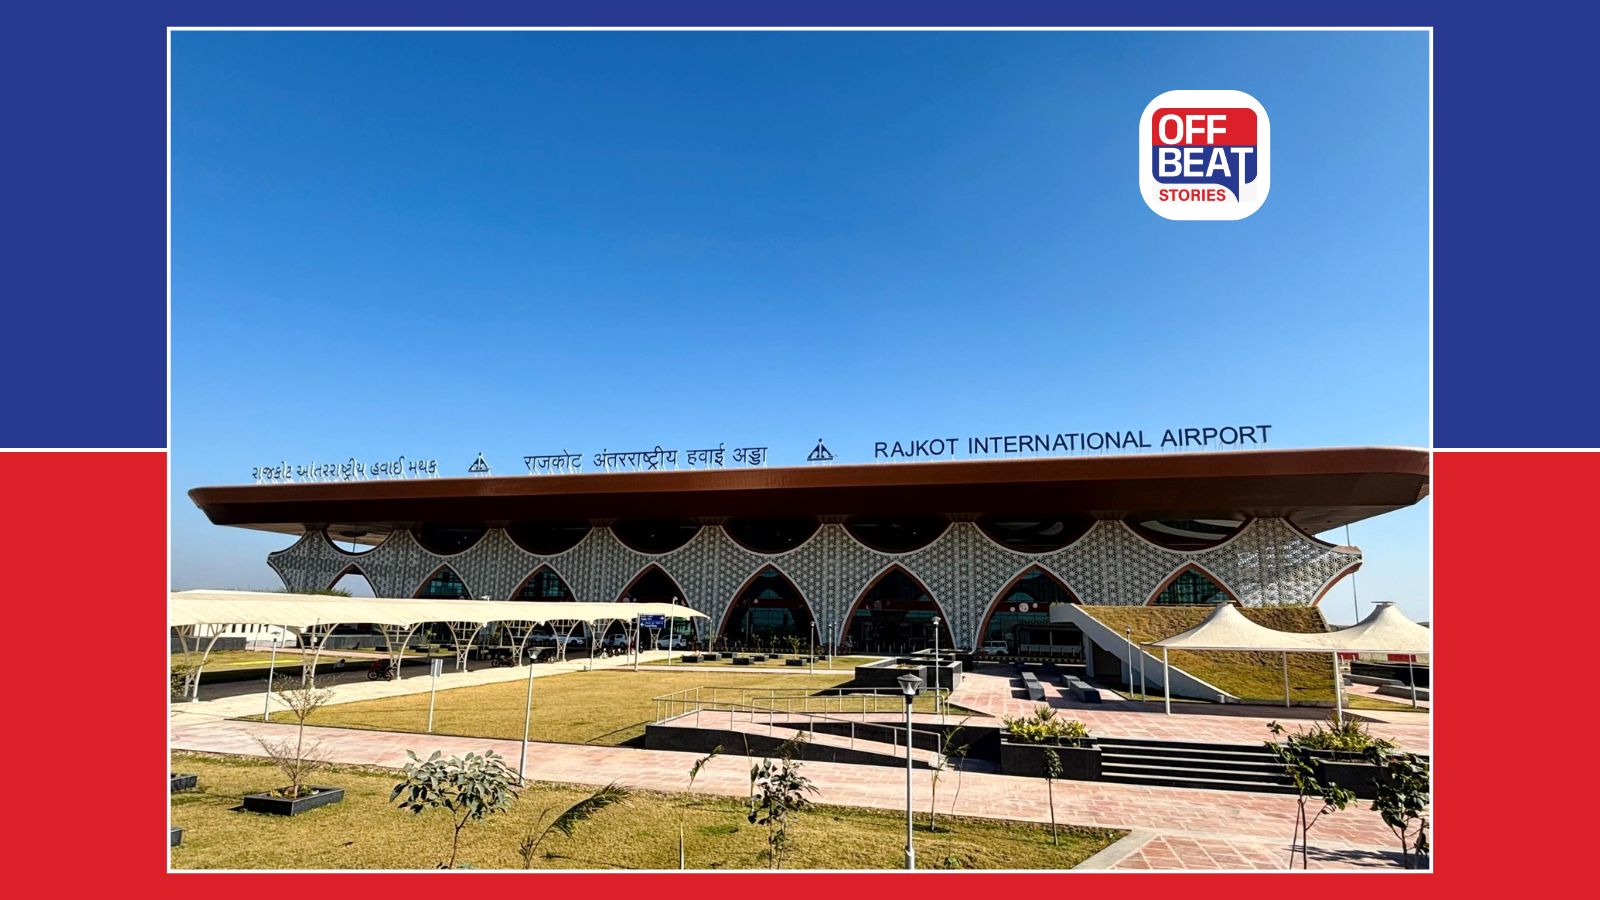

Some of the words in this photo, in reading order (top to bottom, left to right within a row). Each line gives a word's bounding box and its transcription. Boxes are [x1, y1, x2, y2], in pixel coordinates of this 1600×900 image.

[874, 438, 959, 458] RAJKOT
[968, 430, 1151, 454] INTERNATIONAL
[1160, 425, 1272, 447] AIRPORT
[252, 461, 292, 479] રાજકોટ
[370, 456, 405, 476] હવાઈ
[408, 459, 438, 474] મથક
[523, 449, 582, 470] राजकोट
[593, 446, 678, 470] अंतरराष्ट्रीय
[687, 443, 725, 466] हवाई
[732, 447, 768, 465] अड्डा
